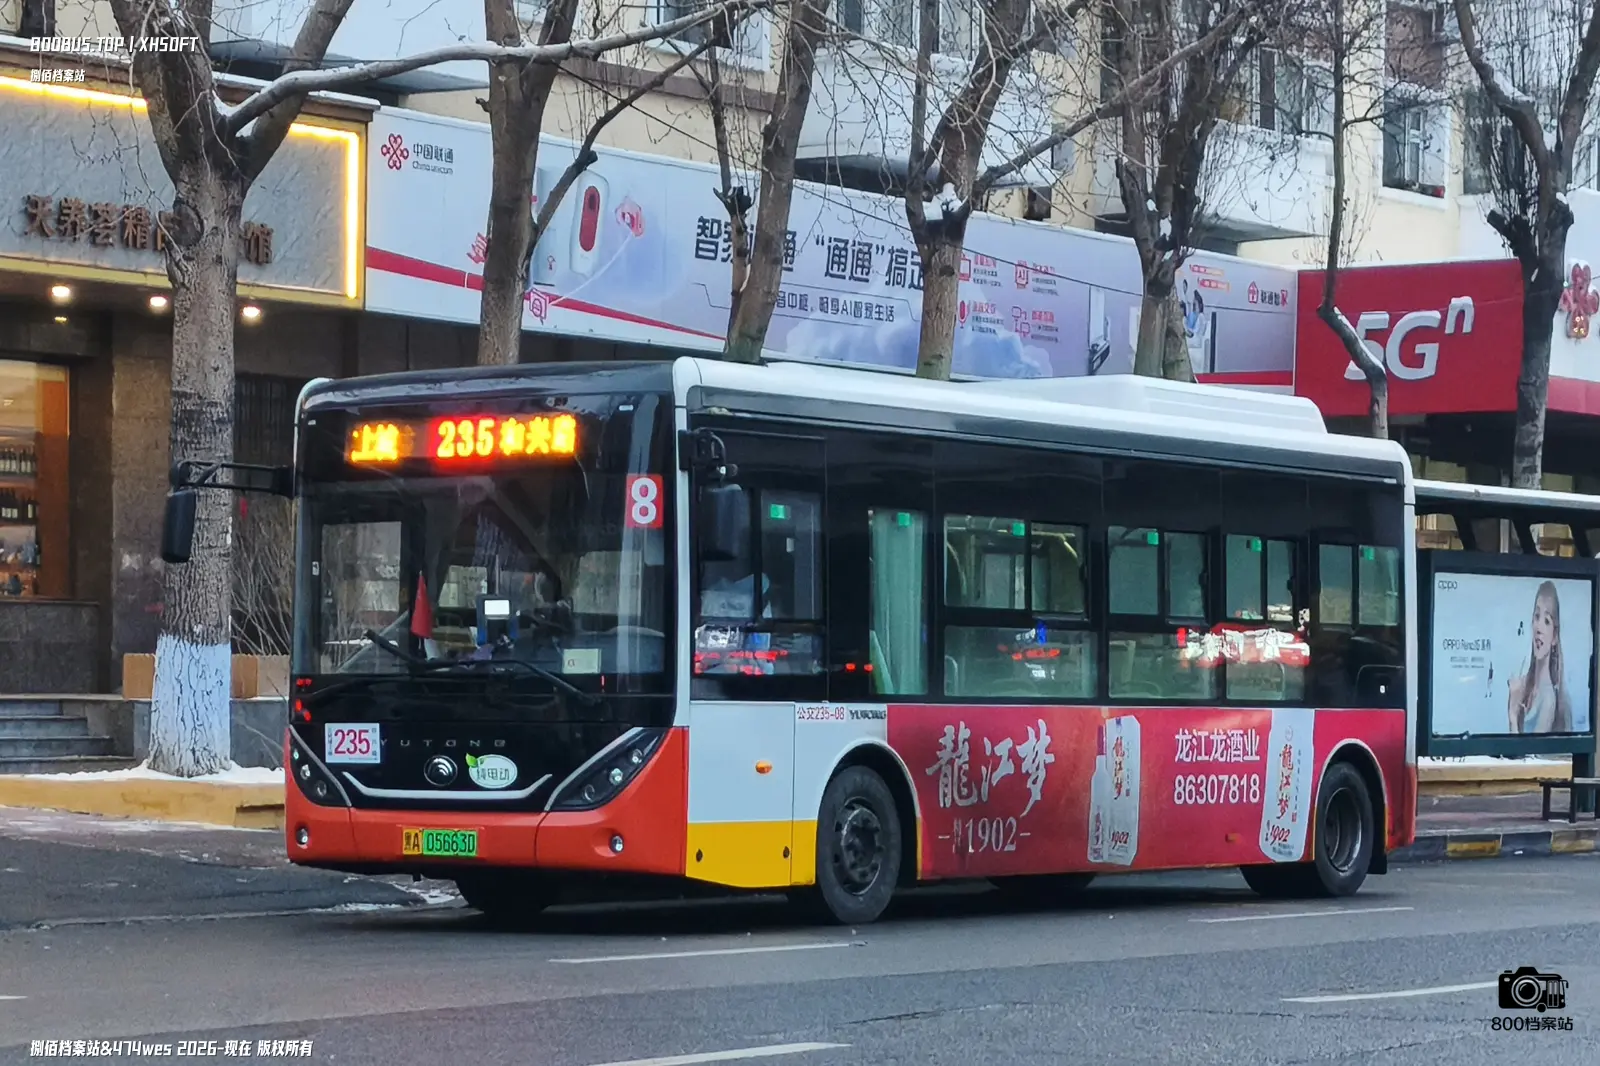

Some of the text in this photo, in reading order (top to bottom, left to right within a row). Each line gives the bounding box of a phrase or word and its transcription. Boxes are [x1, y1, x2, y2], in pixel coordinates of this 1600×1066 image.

[413, 143, 454, 163] 中国联通
[631, 477, 658, 525] 8
[334, 729, 371, 755] 235
[1174, 728, 1261, 763] 龙江龙酒业
[1173, 773, 1261, 805] 86307818
